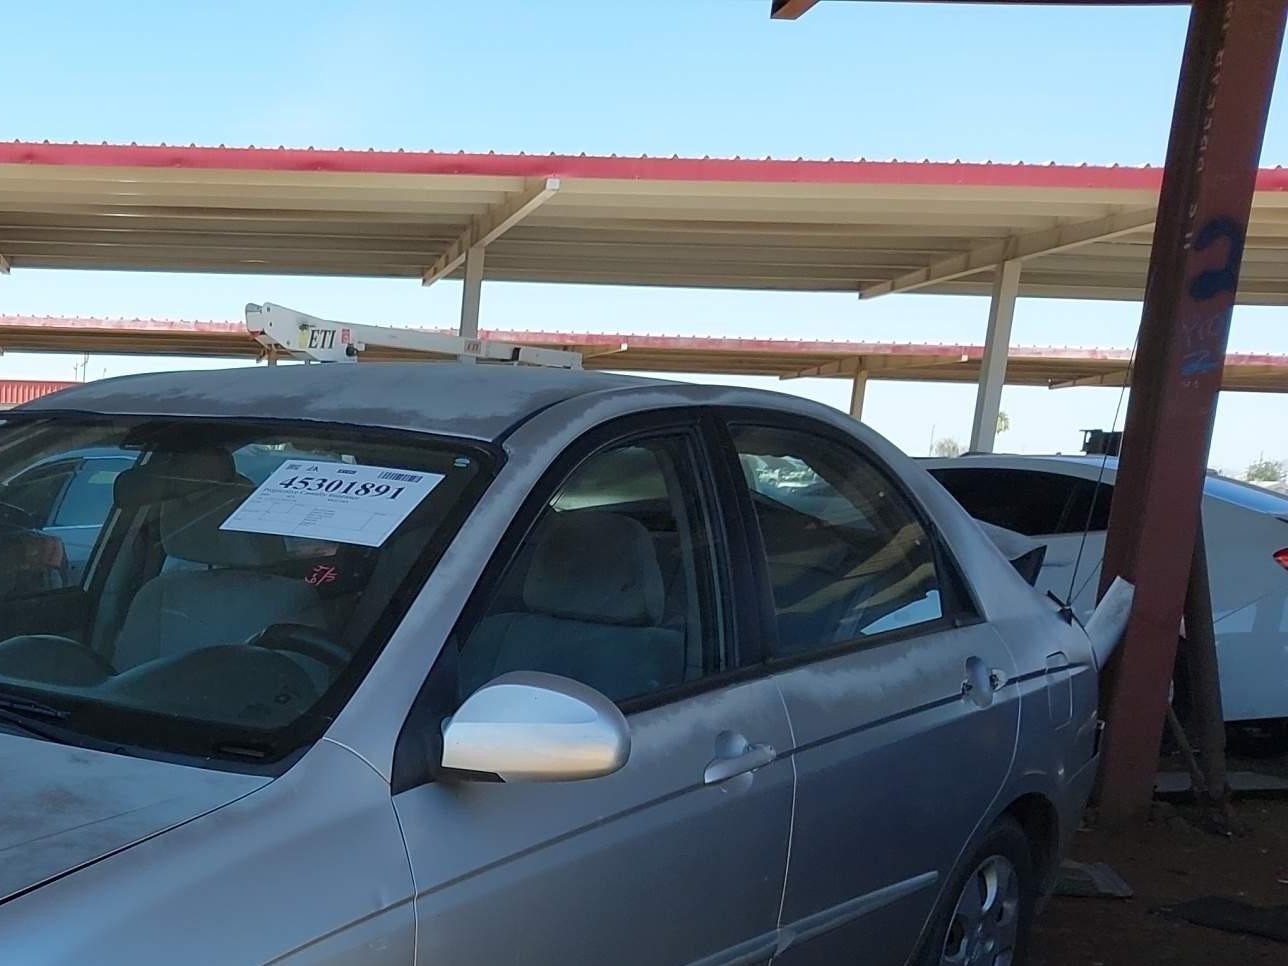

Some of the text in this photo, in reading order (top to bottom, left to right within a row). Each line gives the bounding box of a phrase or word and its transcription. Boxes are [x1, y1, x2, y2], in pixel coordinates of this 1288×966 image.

[1190, 214, 1241, 299] 2
[309, 329, 336, 349] ETI
[280, 475, 406, 500] 45301891
